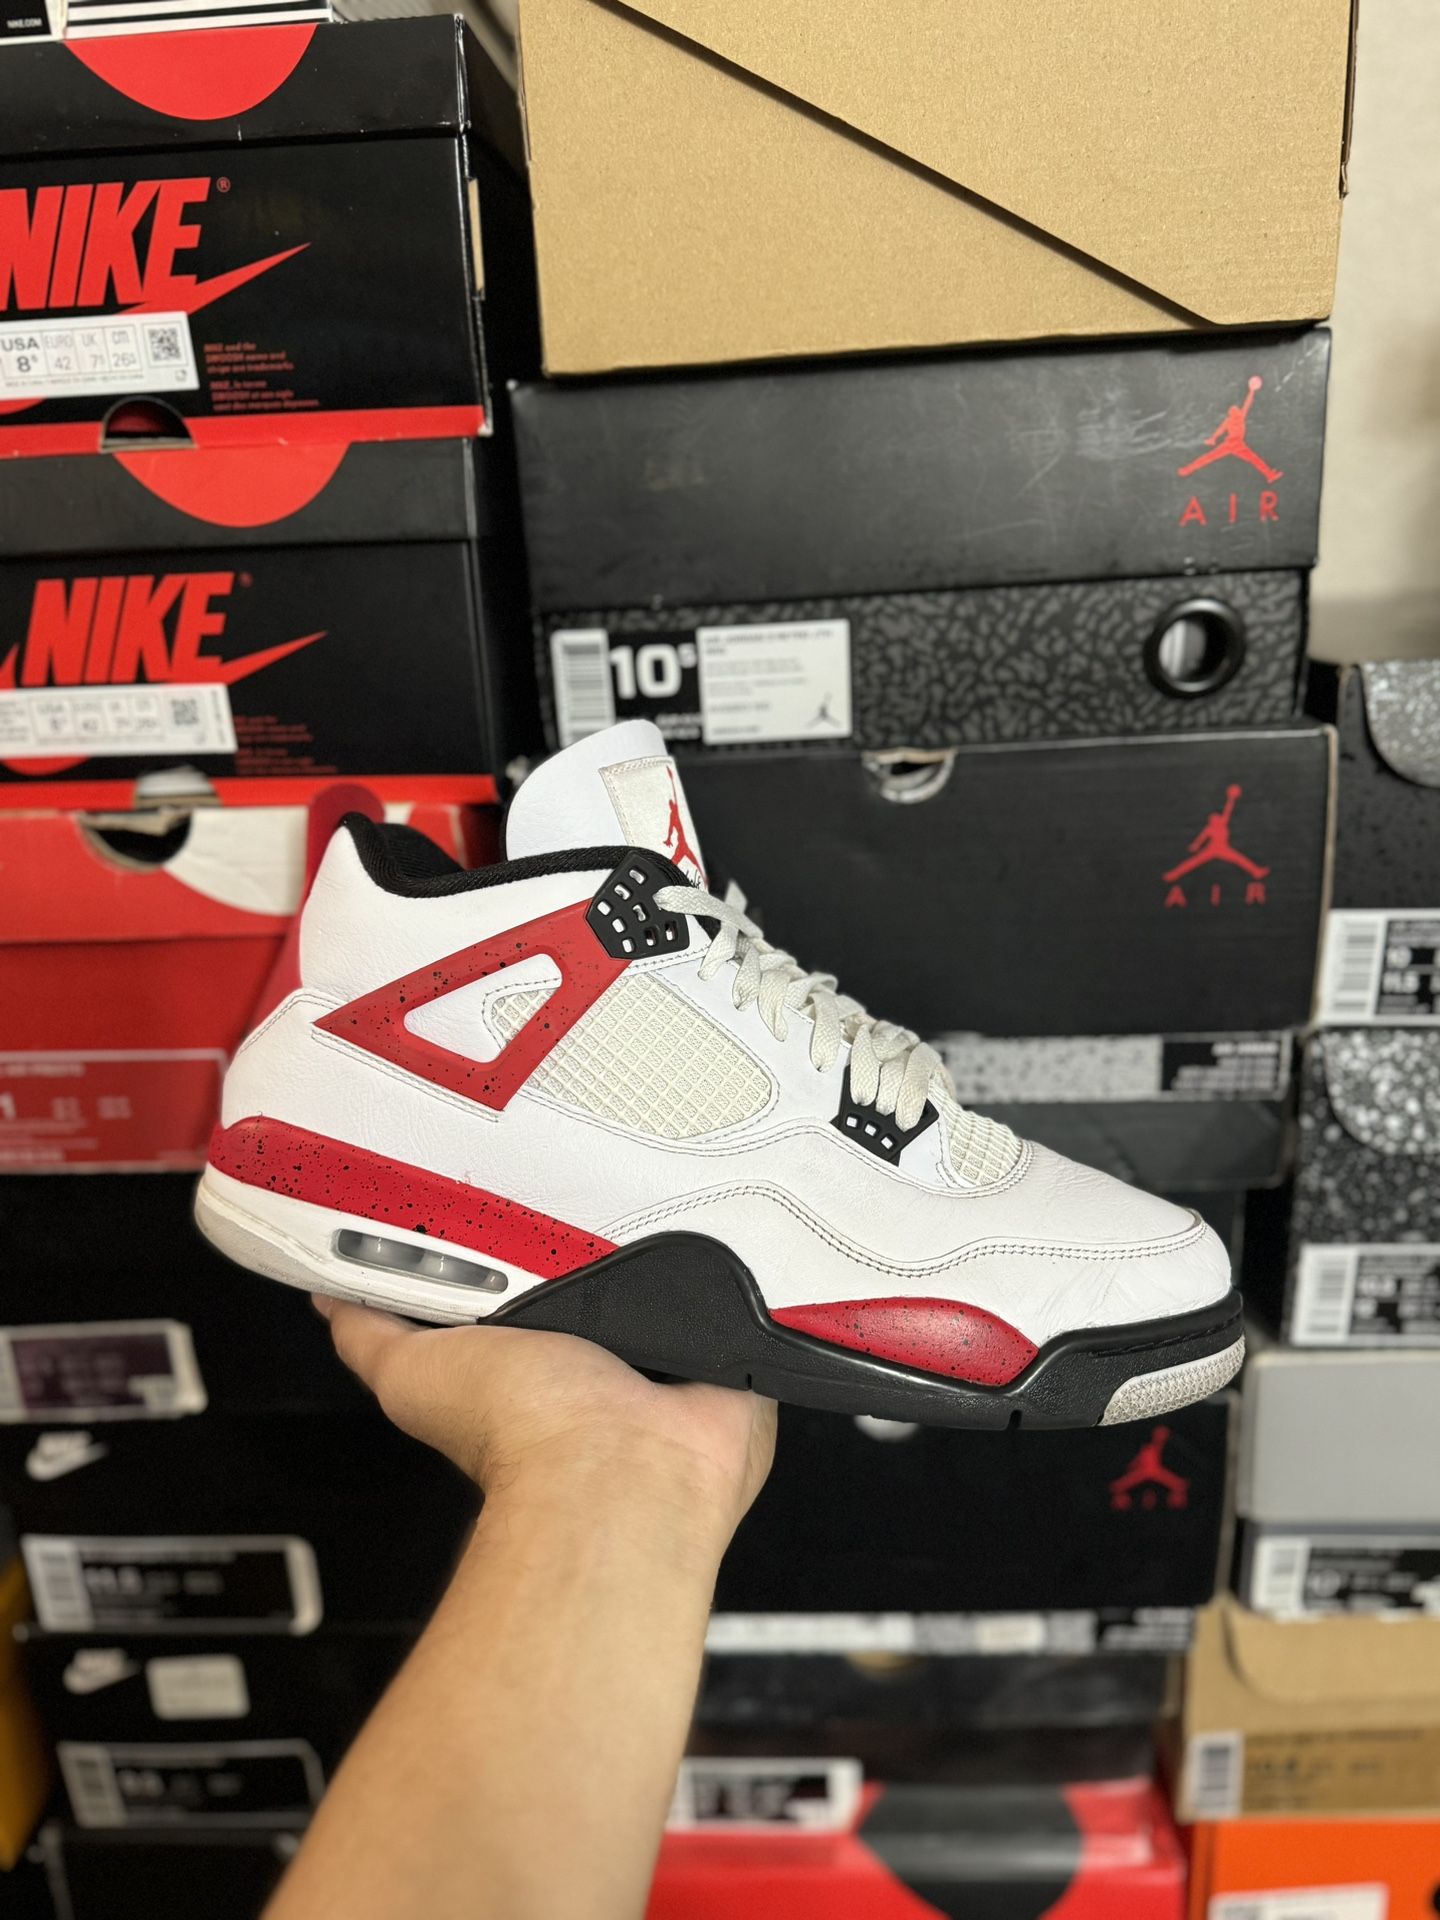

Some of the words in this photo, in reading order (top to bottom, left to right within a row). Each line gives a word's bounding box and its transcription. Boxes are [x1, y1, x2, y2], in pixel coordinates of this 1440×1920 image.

[0, 177, 211, 311] NIKE
[1, 337, 40, 351] USA
[1178, 490, 1279, 527] AIR
[21, 572, 235, 685] NIKE
[1164, 881, 1266, 908] AIR
